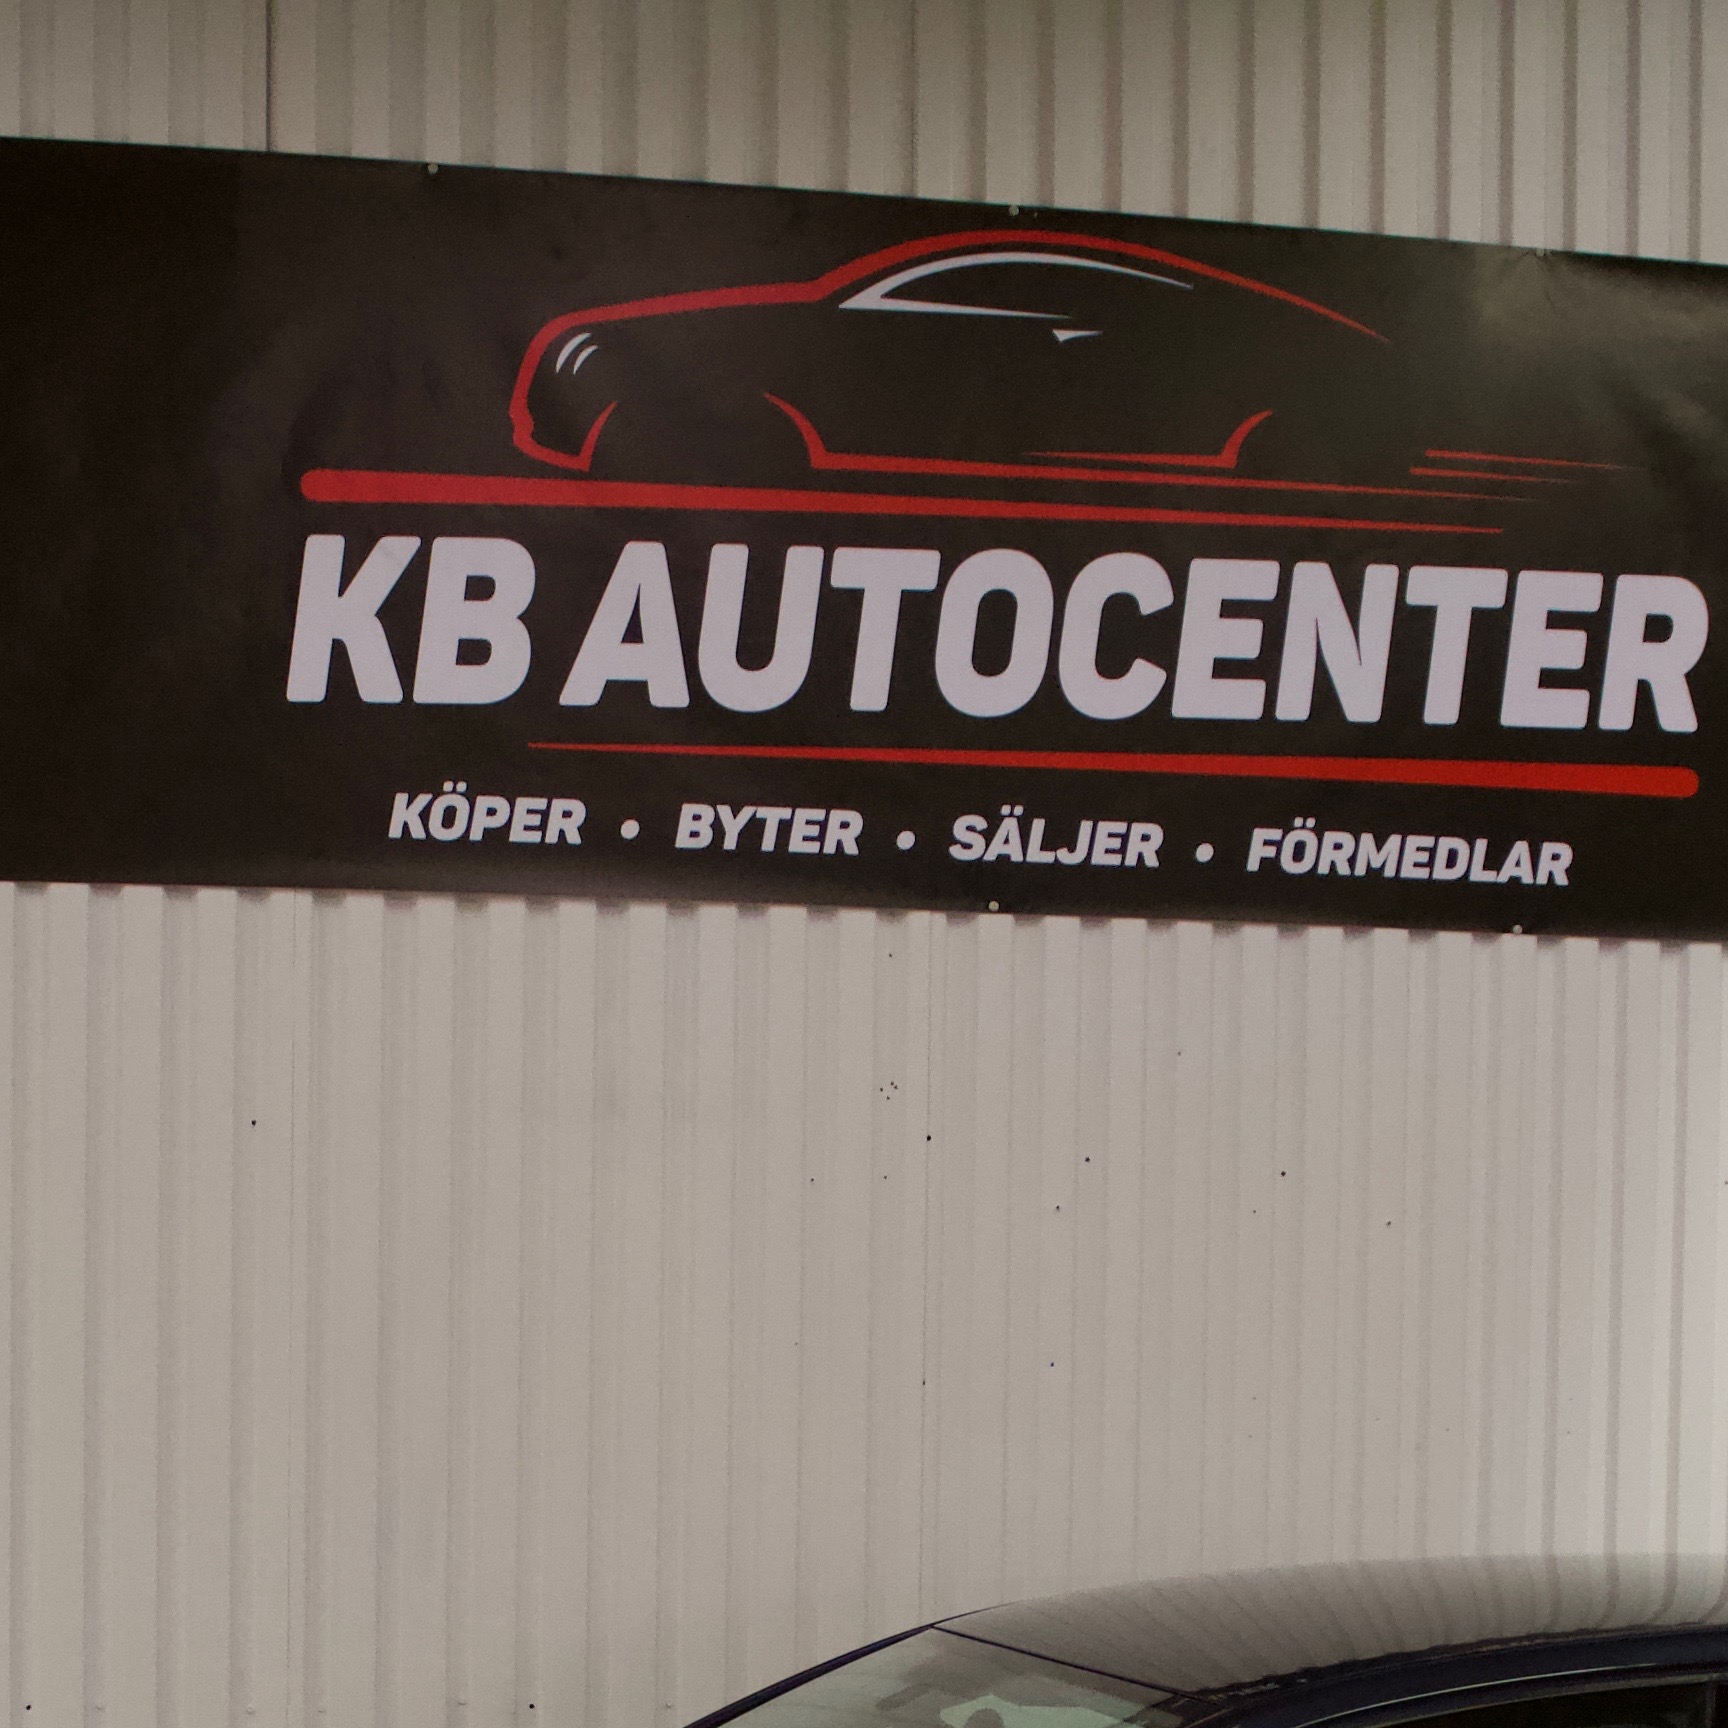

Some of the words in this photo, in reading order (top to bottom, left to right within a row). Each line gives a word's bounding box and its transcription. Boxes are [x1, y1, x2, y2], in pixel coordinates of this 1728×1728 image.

[285, 533, 537, 706] KB
[557, 540, 1710, 734] AUTOCENTER
[387, 780, 587, 846] KÖPER
[673, 802, 865, 856] BYTER
[947, 804, 1165, 869] SÄLJER
[1245, 815, 1574, 887] FÖRMEDLAR
